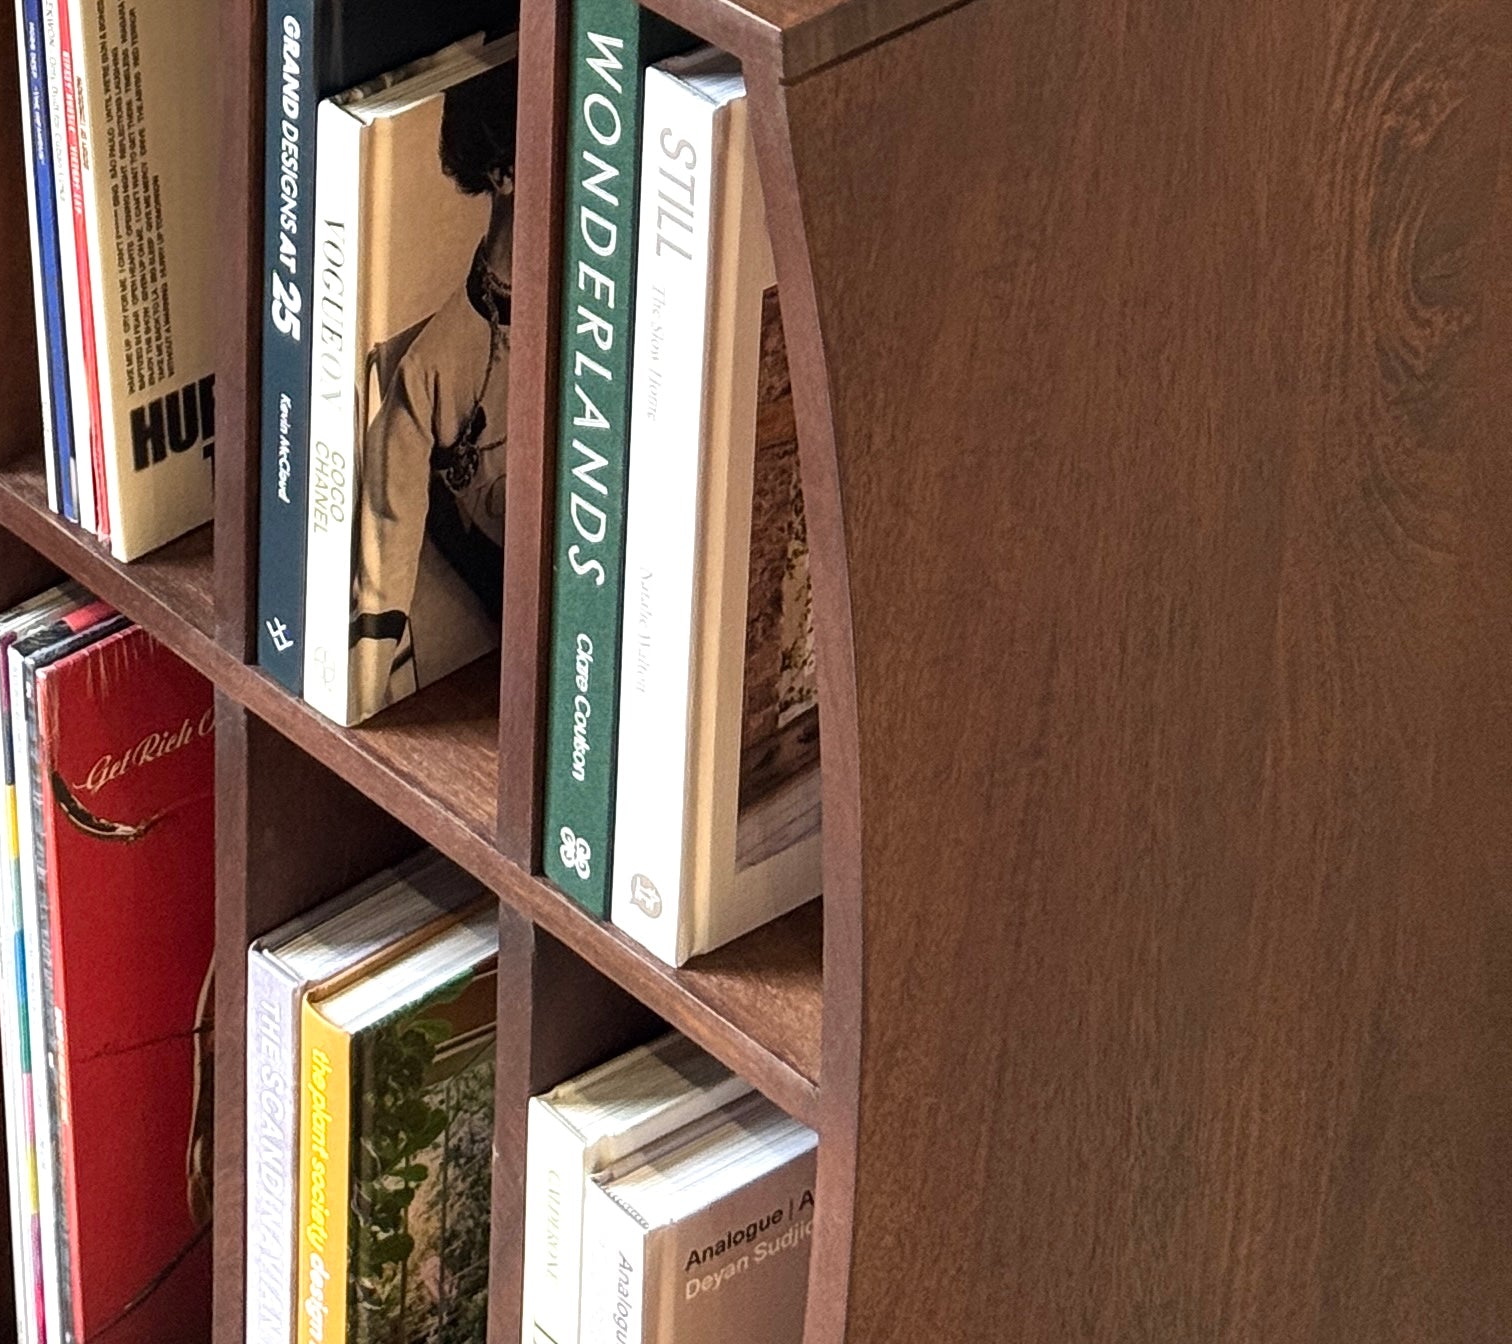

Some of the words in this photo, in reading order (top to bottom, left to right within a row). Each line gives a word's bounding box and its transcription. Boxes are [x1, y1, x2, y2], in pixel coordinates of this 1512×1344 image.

[280, 15, 302, 120] GRAND
[106, 127, 116, 158] PAULO
[278, 120, 300, 230] DESIGNS
[656, 127, 696, 260] STILL
[278, 231, 298, 274] AT
[320, 219, 345, 352] VOGUE
[121, 294, 130, 313] FOR
[270, 270, 302, 341] 25
[567, 31, 624, 586] WONDERLANDS
[651, 285, 666, 314] The
[124, 339, 133, 351] UP
[650, 322, 664, 361] Slow
[277, 392, 293, 434] Kevin
[276, 435, 291, 503] McCloud
[313, 441, 330, 533] CHANEL
[330, 451, 345, 522] COCO
[574, 632, 594, 693] Clare
[72, 748, 132, 795] Get
[132, 718, 193, 766] Rich
[259, 999, 282, 1063] THE
[312, 1048, 332, 1086] the
[307, 1084, 332, 1161] plant
[259, 1064, 287, 1338] SCANDINAVIAN
[306, 1158, 330, 1253] society
[685, 1209, 783, 1272] Analogue
[798, 1189, 815, 1212] A
[305, 1253, 330, 1341] design
[613, 1250, 633, 1344] Analogu
[685, 1254, 749, 1300] Deyan
